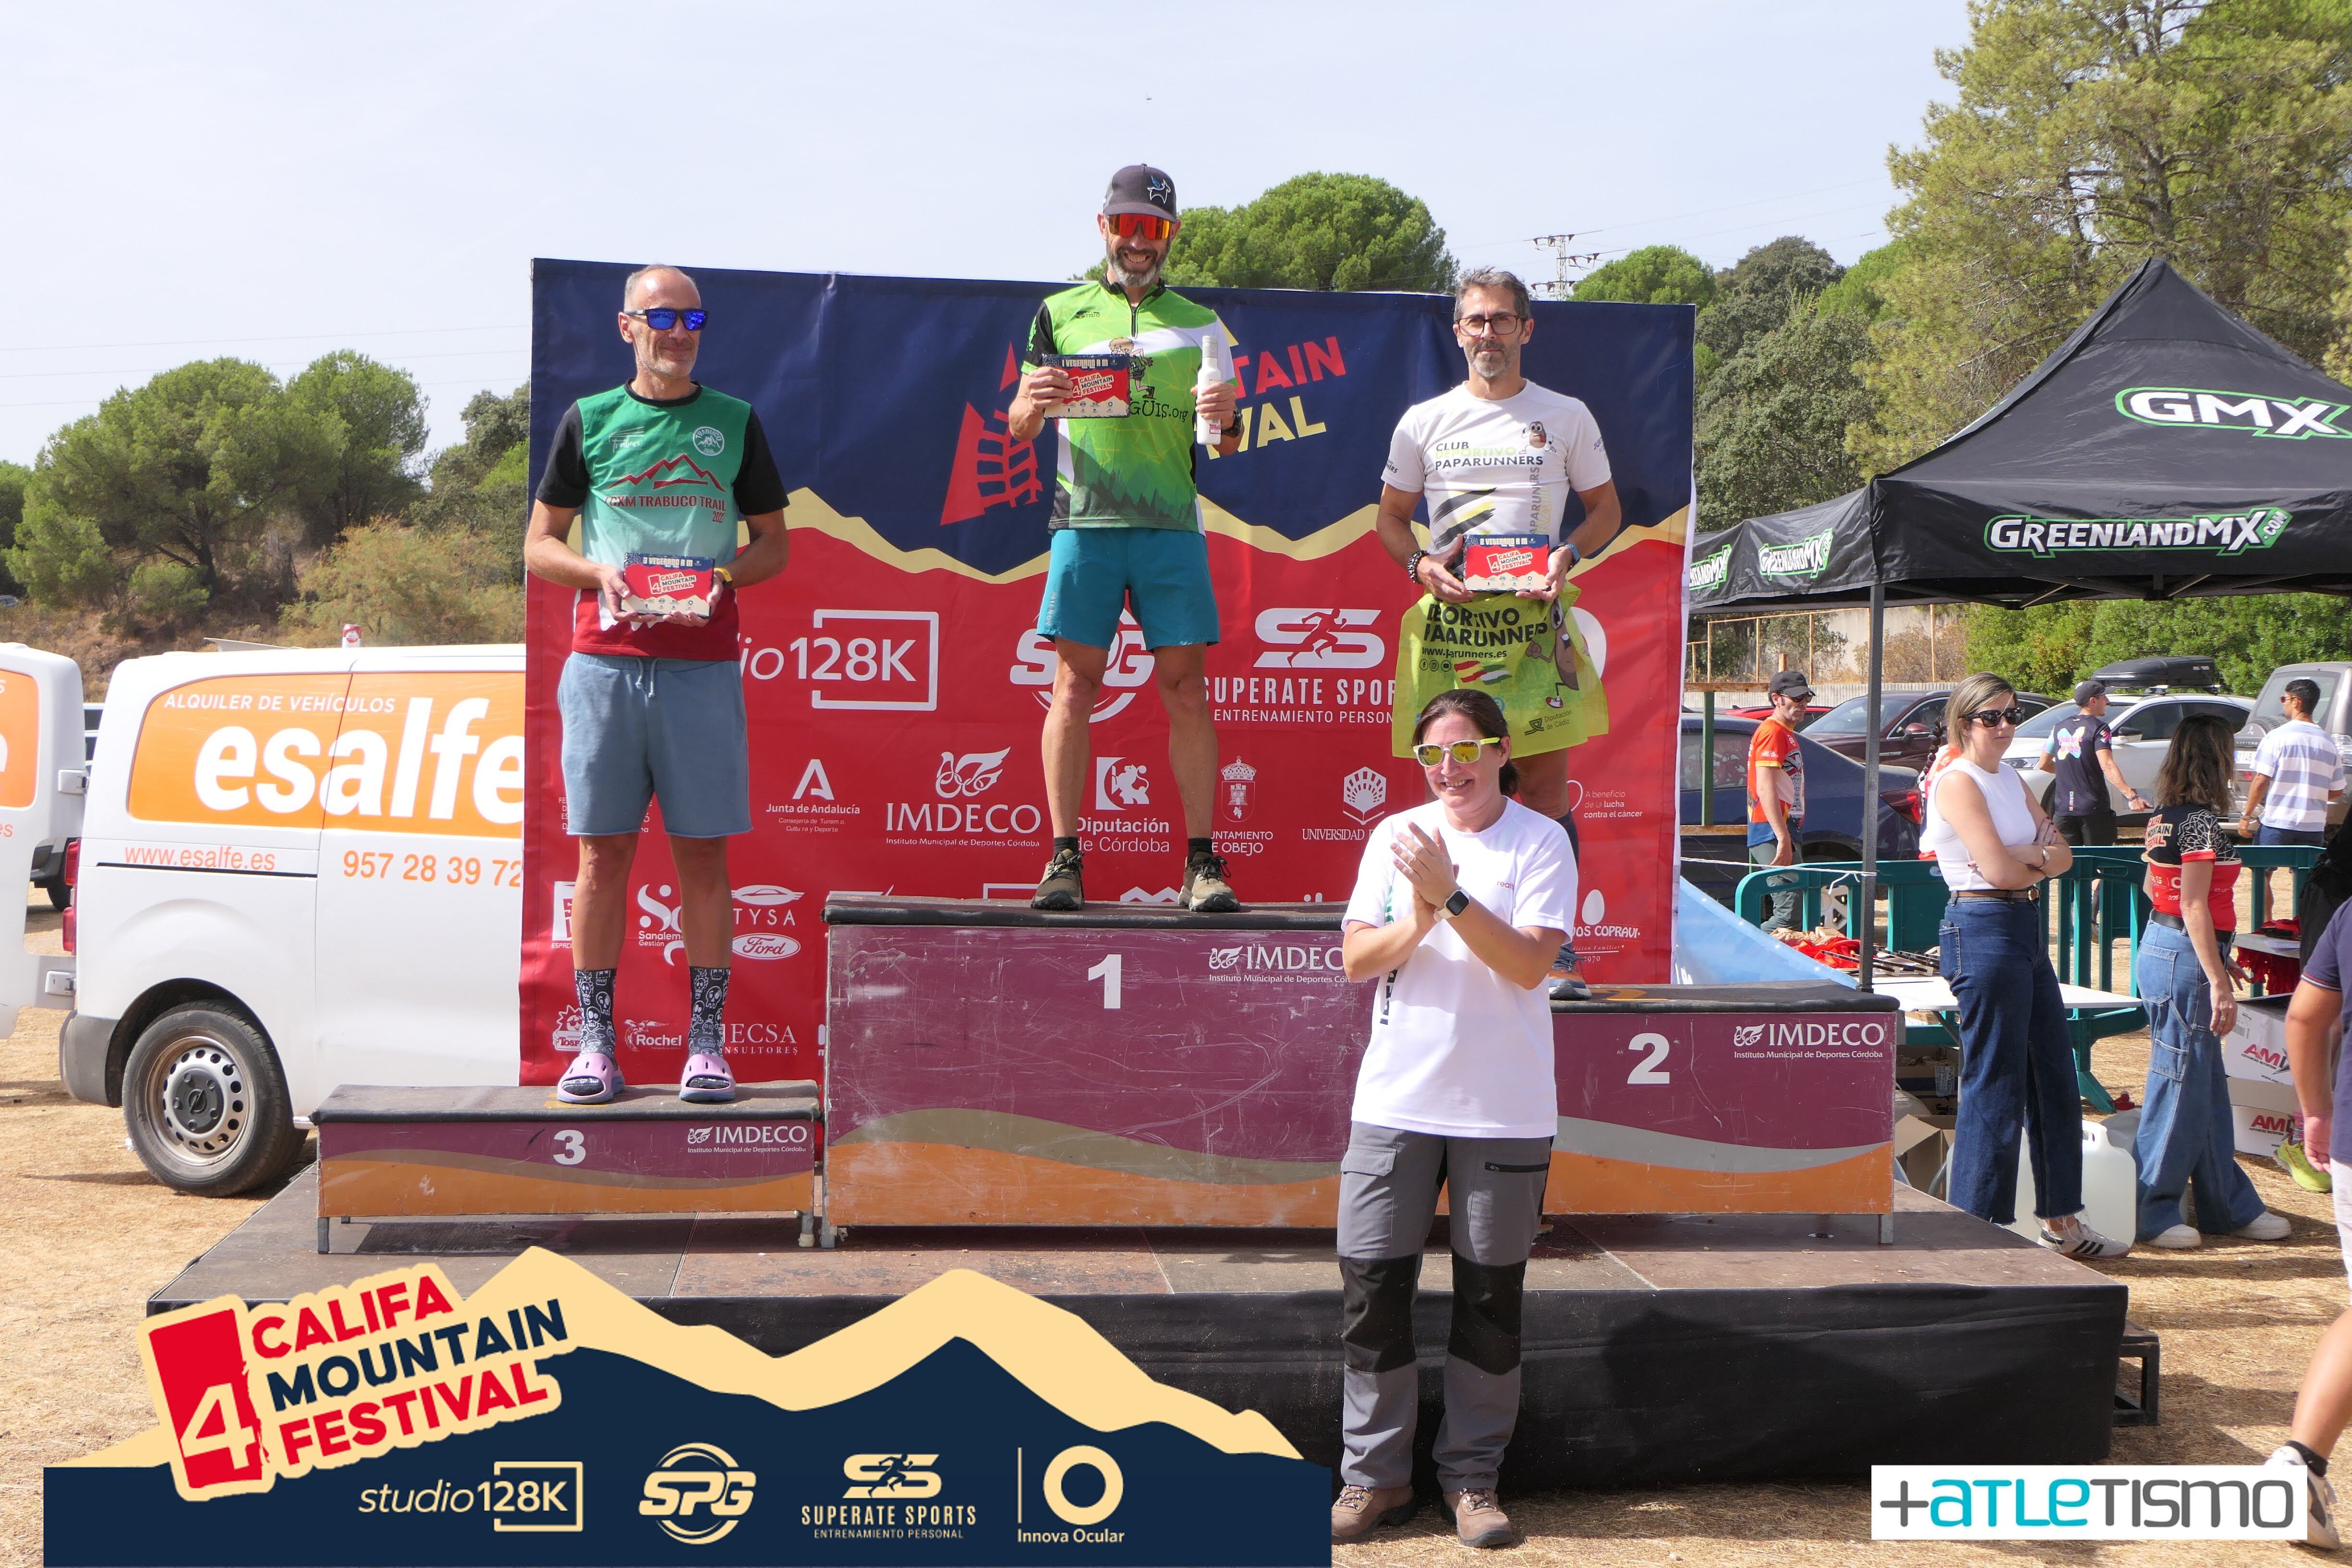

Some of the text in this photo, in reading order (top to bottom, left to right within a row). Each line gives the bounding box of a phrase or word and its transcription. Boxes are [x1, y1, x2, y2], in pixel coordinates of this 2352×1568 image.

[1232, 336, 1346, 400] TAIN
[1079, 374, 1102, 383] CALIFA
[1081, 376, 1113, 389] MOUNTAIN
[1082, 383, 1111, 395] FESTIVAL
[2130, 391, 2338, 435] GMX
[695, 428, 722, 441] TRABUCO
[1435, 447, 1516, 459] DEPORTIVO
[1436, 441, 1469, 451] CLUB
[1435, 456, 1543, 471] PAPARUNNERS
[639, 495, 698, 508] TRABUCO
[700, 496, 726, 511] TRAIL
[1499, 551, 1520, 559] CALIFA
[1501, 553, 1532, 564] MOUNTAIN
[1502, 559, 1530, 570] FESTIVAL
[661, 572, 683, 581] CALIFA
[662, 576, 696, 586] MOUNTAIN
[663, 582, 693, 592] FESTIVAL
[1337, 679, 1395, 705] SPOR
[164, 693, 395, 713] ALQUILER DE VEHÍCULOS
[1214, 709, 1394, 723] ENTRENAMIENTO PERSON
[1544, 710, 1572, 722] Diputación
[1554, 718, 1570, 728] Cádiz
[194, 697, 525, 824] esalfe
[766, 803, 860, 814] Junta de Andalucía
[885, 802, 1042, 834] IMDECO
[1211, 830, 1273, 840] UNTAMIENTO
[1302, 828, 1365, 840] UNIVERSIDAD
[919, 838, 957, 847] Municipal
[970, 839, 1006, 847] Deportes
[1007, 839, 1040, 847] Córdoba
[1099, 837, 1170, 852] Córdoba
[1221, 842, 1264, 856] OBEJO
[124, 846, 275, 872] www.esalfe.es
[343, 850, 392, 878] 957
[403, 854, 437, 882] 28
[448, 857, 481, 885] 39
[733, 908, 796, 926] TYSA
[742, 936, 787, 955] Ford
[1247, 946, 1344, 971] IMDEC
[1088, 954, 1122, 1009] 1
[1243, 974, 1283, 984] Municipal
[1284, 974, 1295, 983] de
[1296, 975, 1333, 984] Deportes
[636, 1034, 682, 1046] Rochel
[1769, 1023, 1884, 1046] IMDECO
[725, 1046, 798, 1055] NSULTORES
[1766, 1051, 1803, 1059] Municipal
[1816, 1051, 1850, 1059] Deportes
[1851, 1050, 1883, 1058] Córdoba
[2243, 1044, 2288, 1068] AMI
[1627, 1033, 1670, 1084] 2
[2241, 1053, 2277, 1070] ADVANCED NUTRITION
[2250, 1114, 2292, 1132] AMI
[715, 1126, 807, 1143] IMDECO
[553, 1130, 586, 1165] 3
